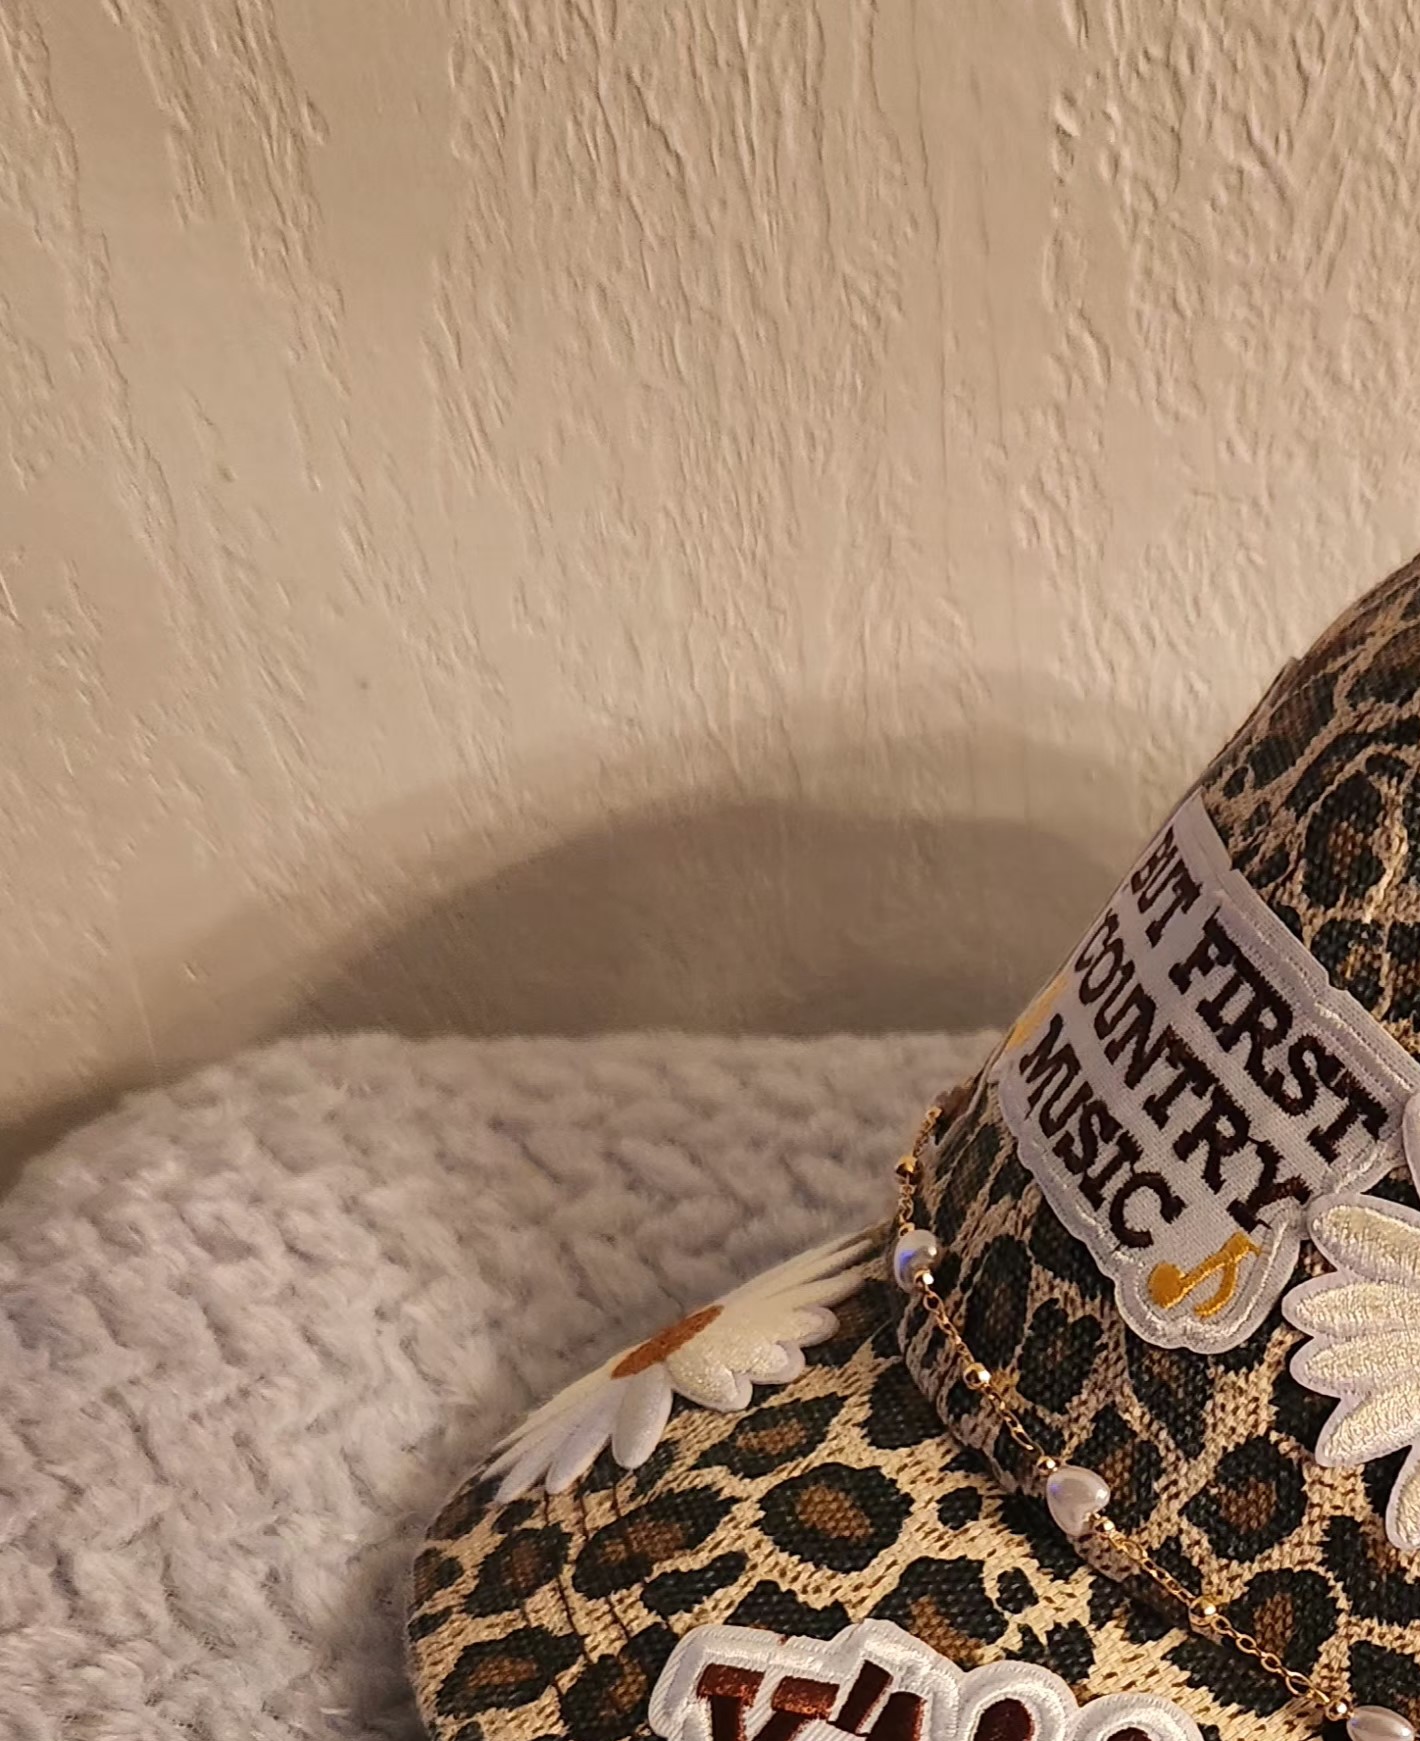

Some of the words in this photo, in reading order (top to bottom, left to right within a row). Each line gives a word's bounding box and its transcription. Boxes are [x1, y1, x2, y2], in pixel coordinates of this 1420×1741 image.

[1020, 1013, 1186, 1249] MUSIC
[1075, 908, 1310, 1232] COUNTRY
[1131, 826, 1204, 947] BUT
[1168, 917, 1389, 1164] FIRST
